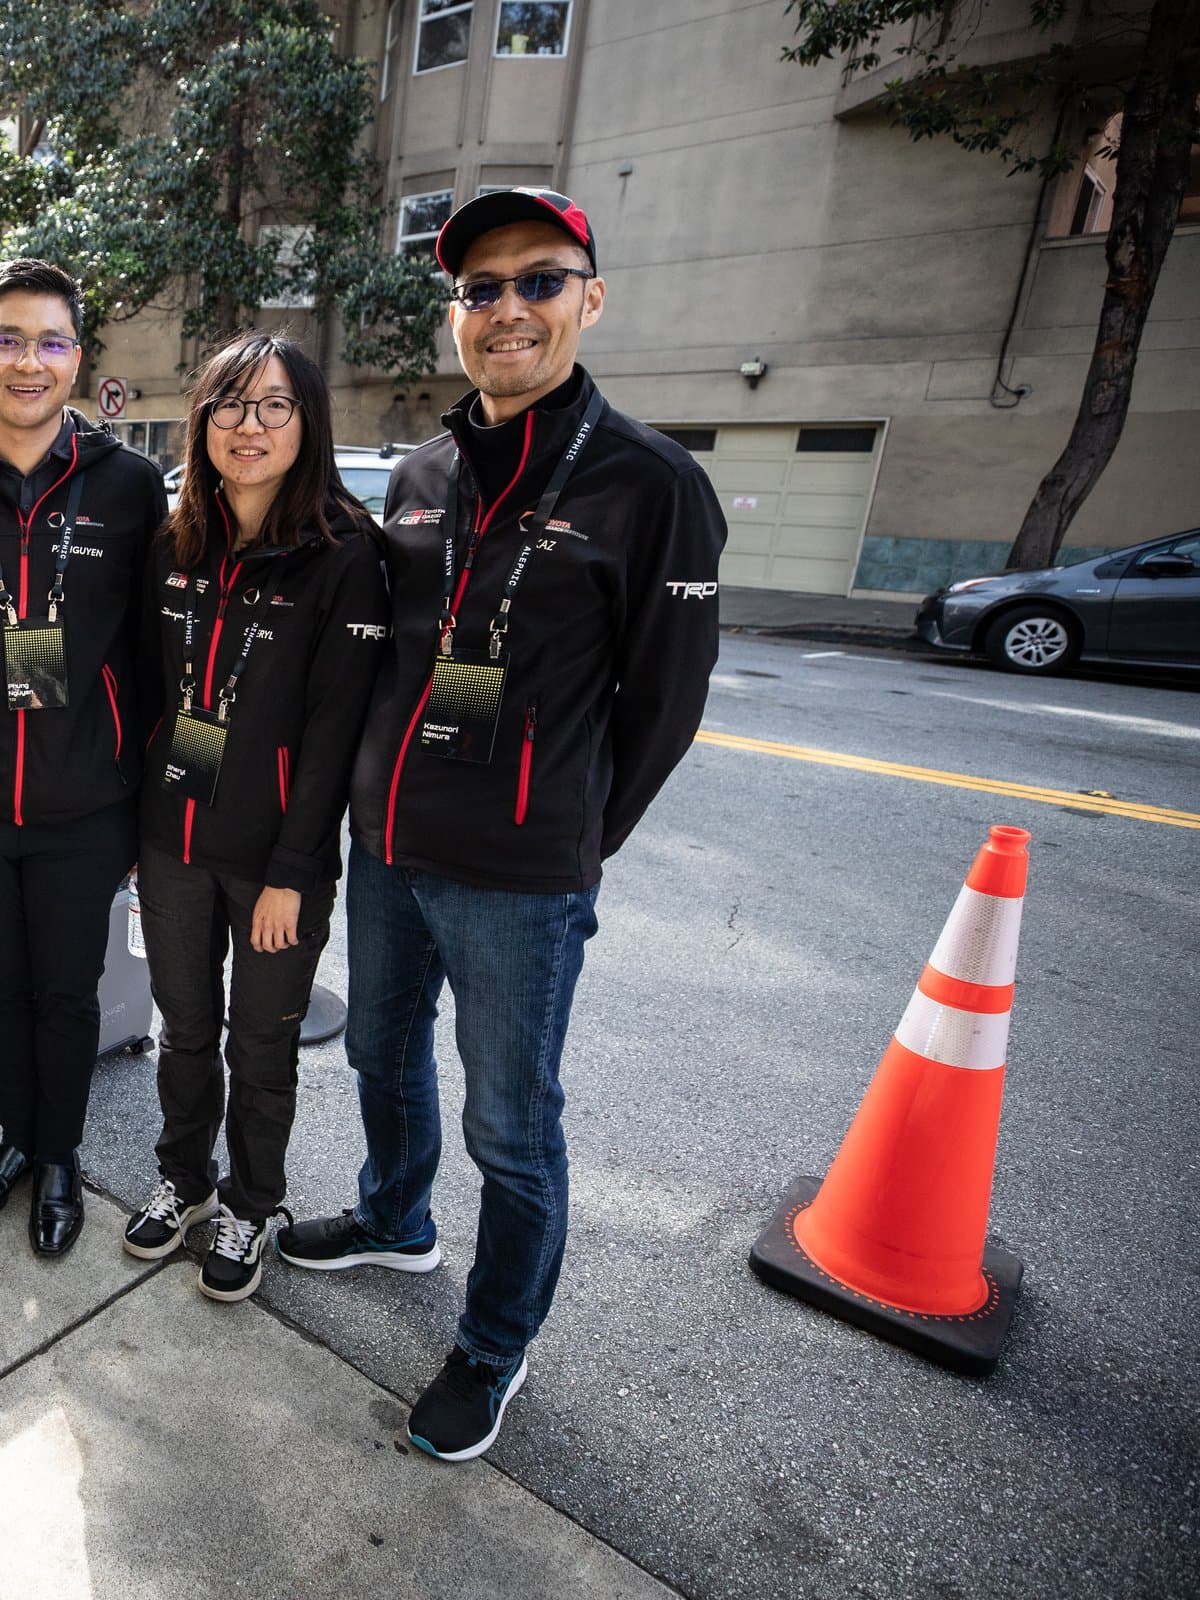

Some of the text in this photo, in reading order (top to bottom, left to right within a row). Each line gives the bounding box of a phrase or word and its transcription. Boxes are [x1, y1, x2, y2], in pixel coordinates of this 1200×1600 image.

[566, 422, 591, 461] ALEPHIC
[60, 526, 72, 560] ALEPHIC
[508, 546, 532, 587] ALEPHIC
[666, 581, 718, 600] TRD
[185, 610, 193, 645] ALEPHIC
[241, 622, 259, 657] ALEPHIC
[346, 623, 387, 641] TRD
[422, 730, 450, 741] Nimura
[423, 722, 459, 734] Kazunori
